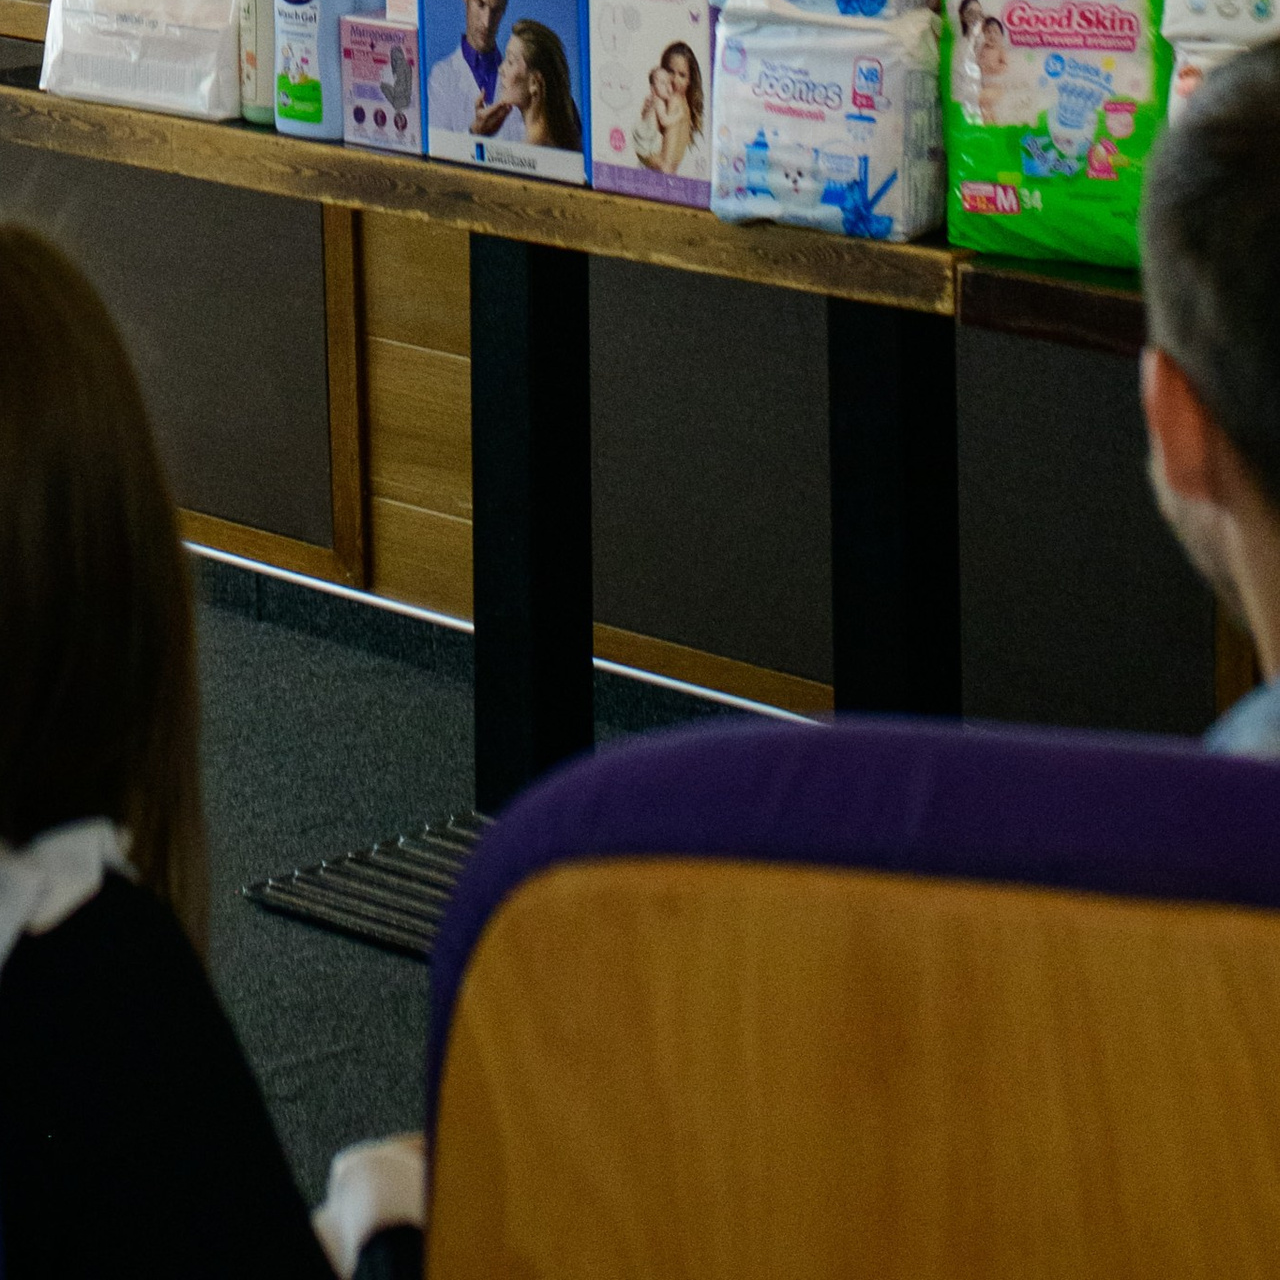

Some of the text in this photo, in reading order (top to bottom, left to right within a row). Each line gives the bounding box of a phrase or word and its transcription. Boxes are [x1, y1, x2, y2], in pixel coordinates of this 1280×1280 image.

[1005, 4, 1135, 34] Good Skin
[996, 184, 1019, 212] M
